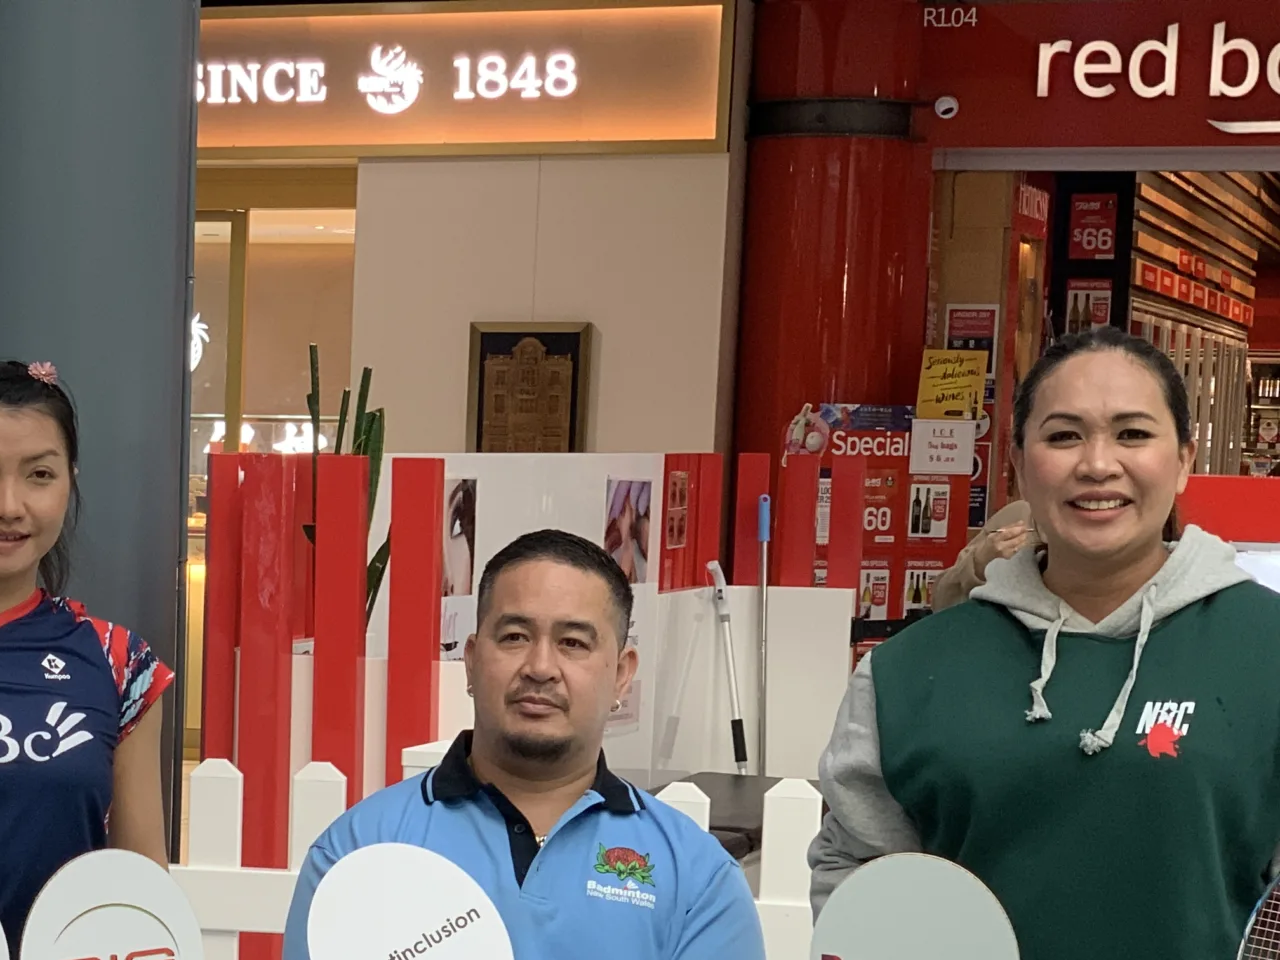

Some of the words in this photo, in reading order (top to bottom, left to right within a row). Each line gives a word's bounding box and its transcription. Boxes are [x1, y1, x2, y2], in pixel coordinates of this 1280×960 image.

[923, 7, 978, 28] R104
[452, 52, 579, 100] 1848
[1037, 22, 1180, 99] red
[1209, 20, 1280, 98] b
[586, 879, 657, 903] Badminton
